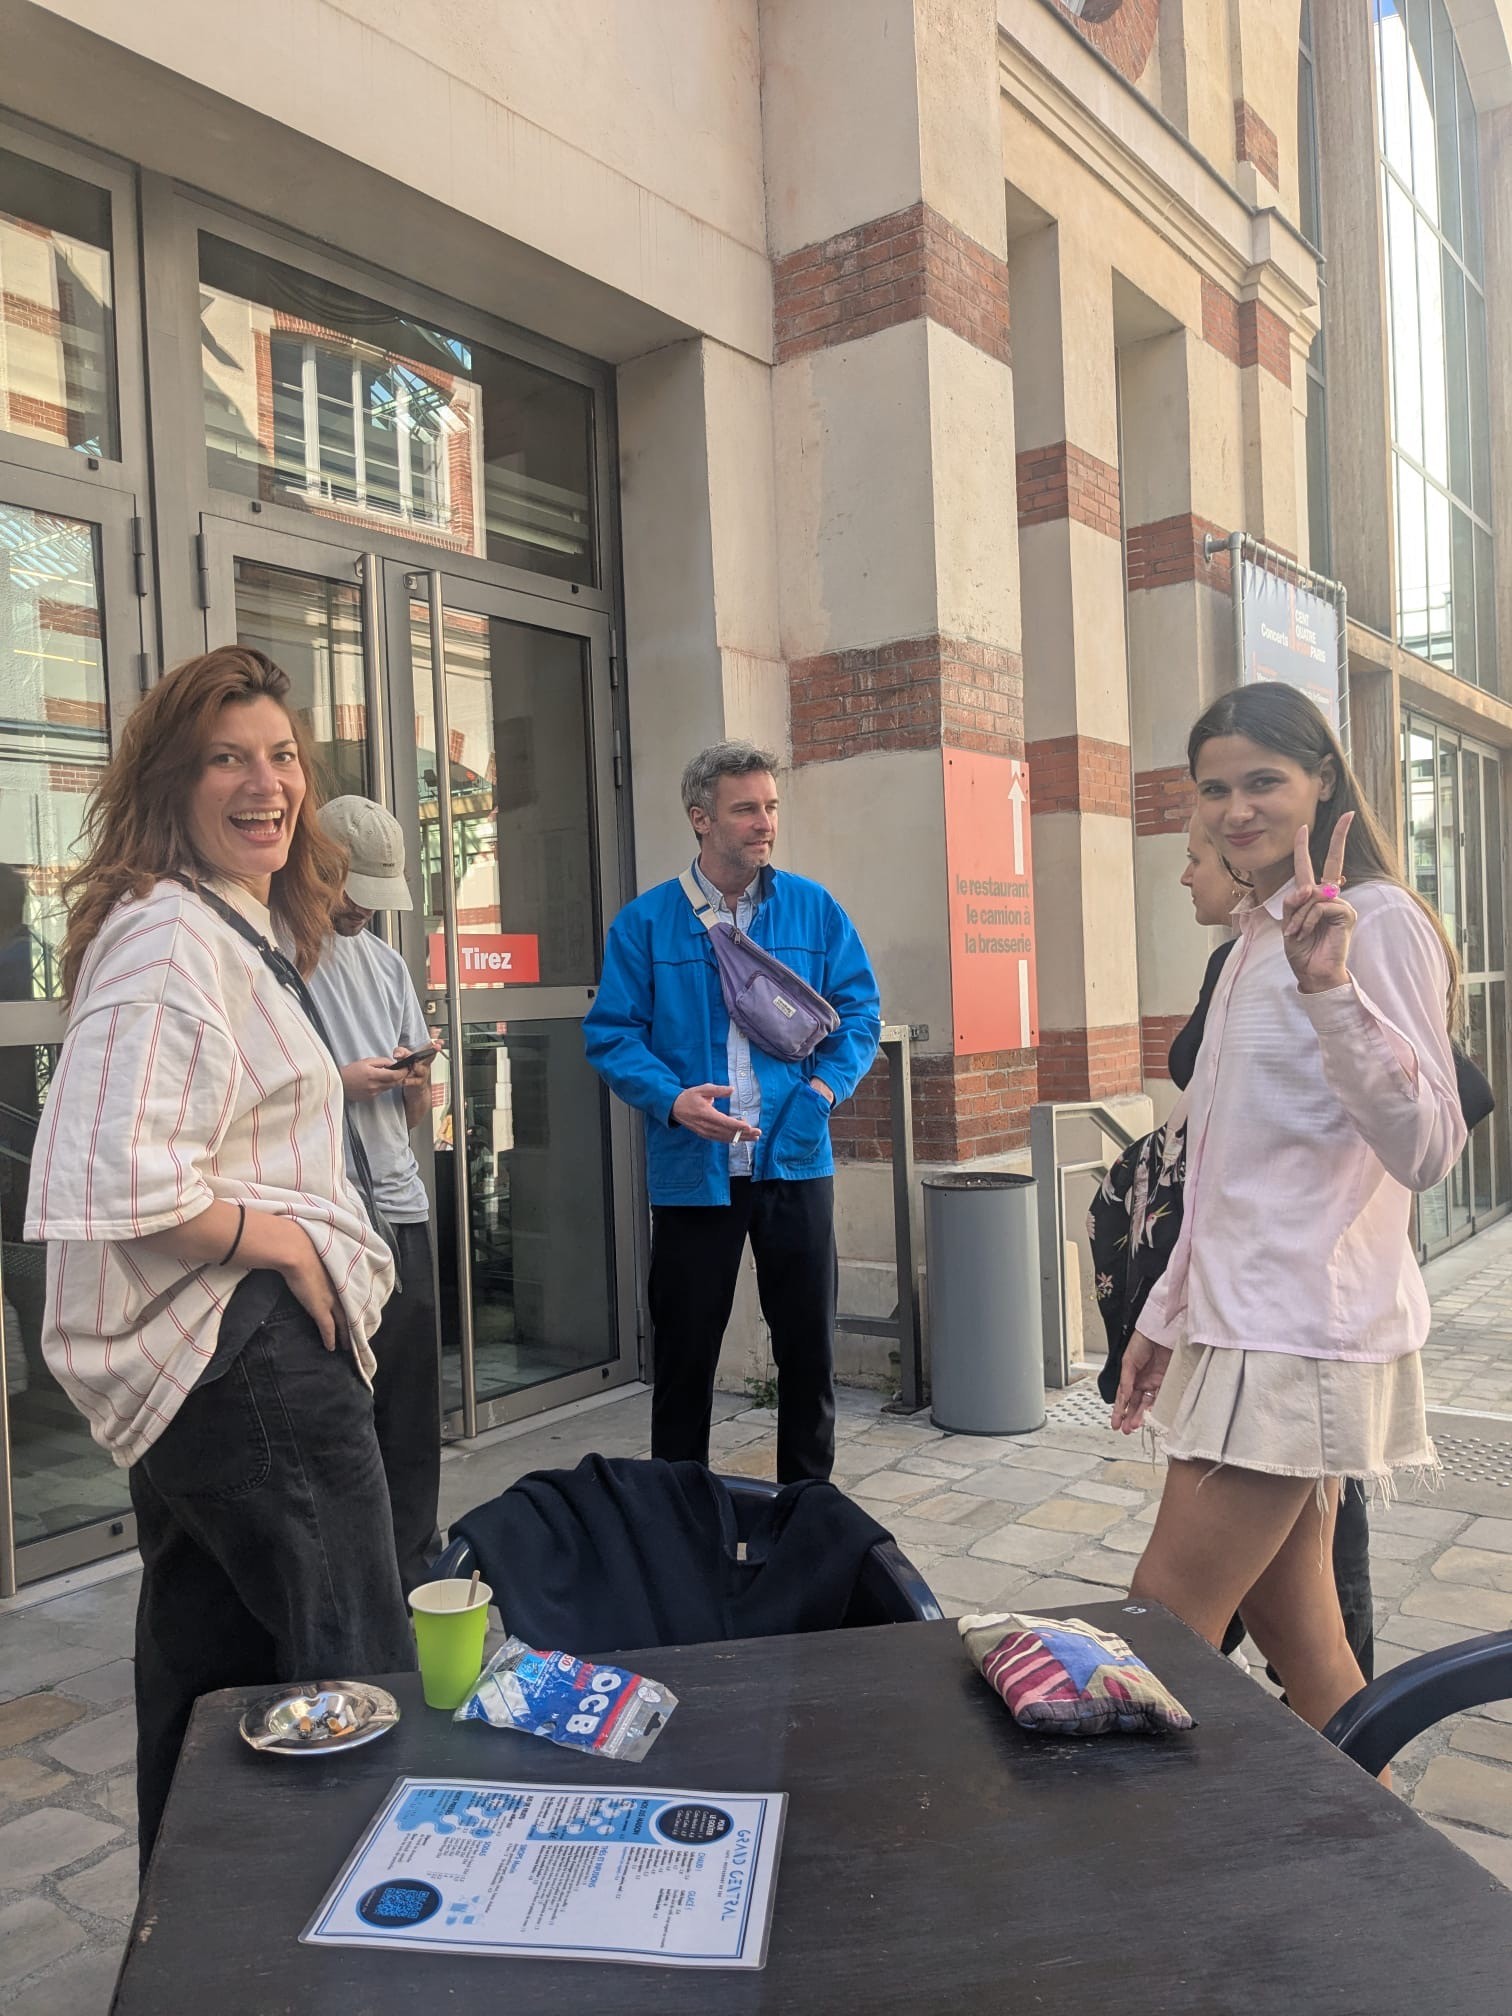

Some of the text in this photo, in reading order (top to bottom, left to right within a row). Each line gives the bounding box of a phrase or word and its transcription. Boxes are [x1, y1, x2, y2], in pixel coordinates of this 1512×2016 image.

[1294, 608, 1309, 626] CENT
[1261, 623, 1289, 648] Concerts
[1295, 624, 1317, 646] QUATRE
[1310, 646, 1326, 664] PARIS
[956, 874, 1030, 898] le restaurant
[966, 904, 1031, 926] le camion à
[965, 933, 1032, 954] la brasserie
[461, 947, 512, 970] Tirez
[565, 1672, 622, 1735] OCB
[721, 1829, 751, 1922] GRAND CENTRAL
